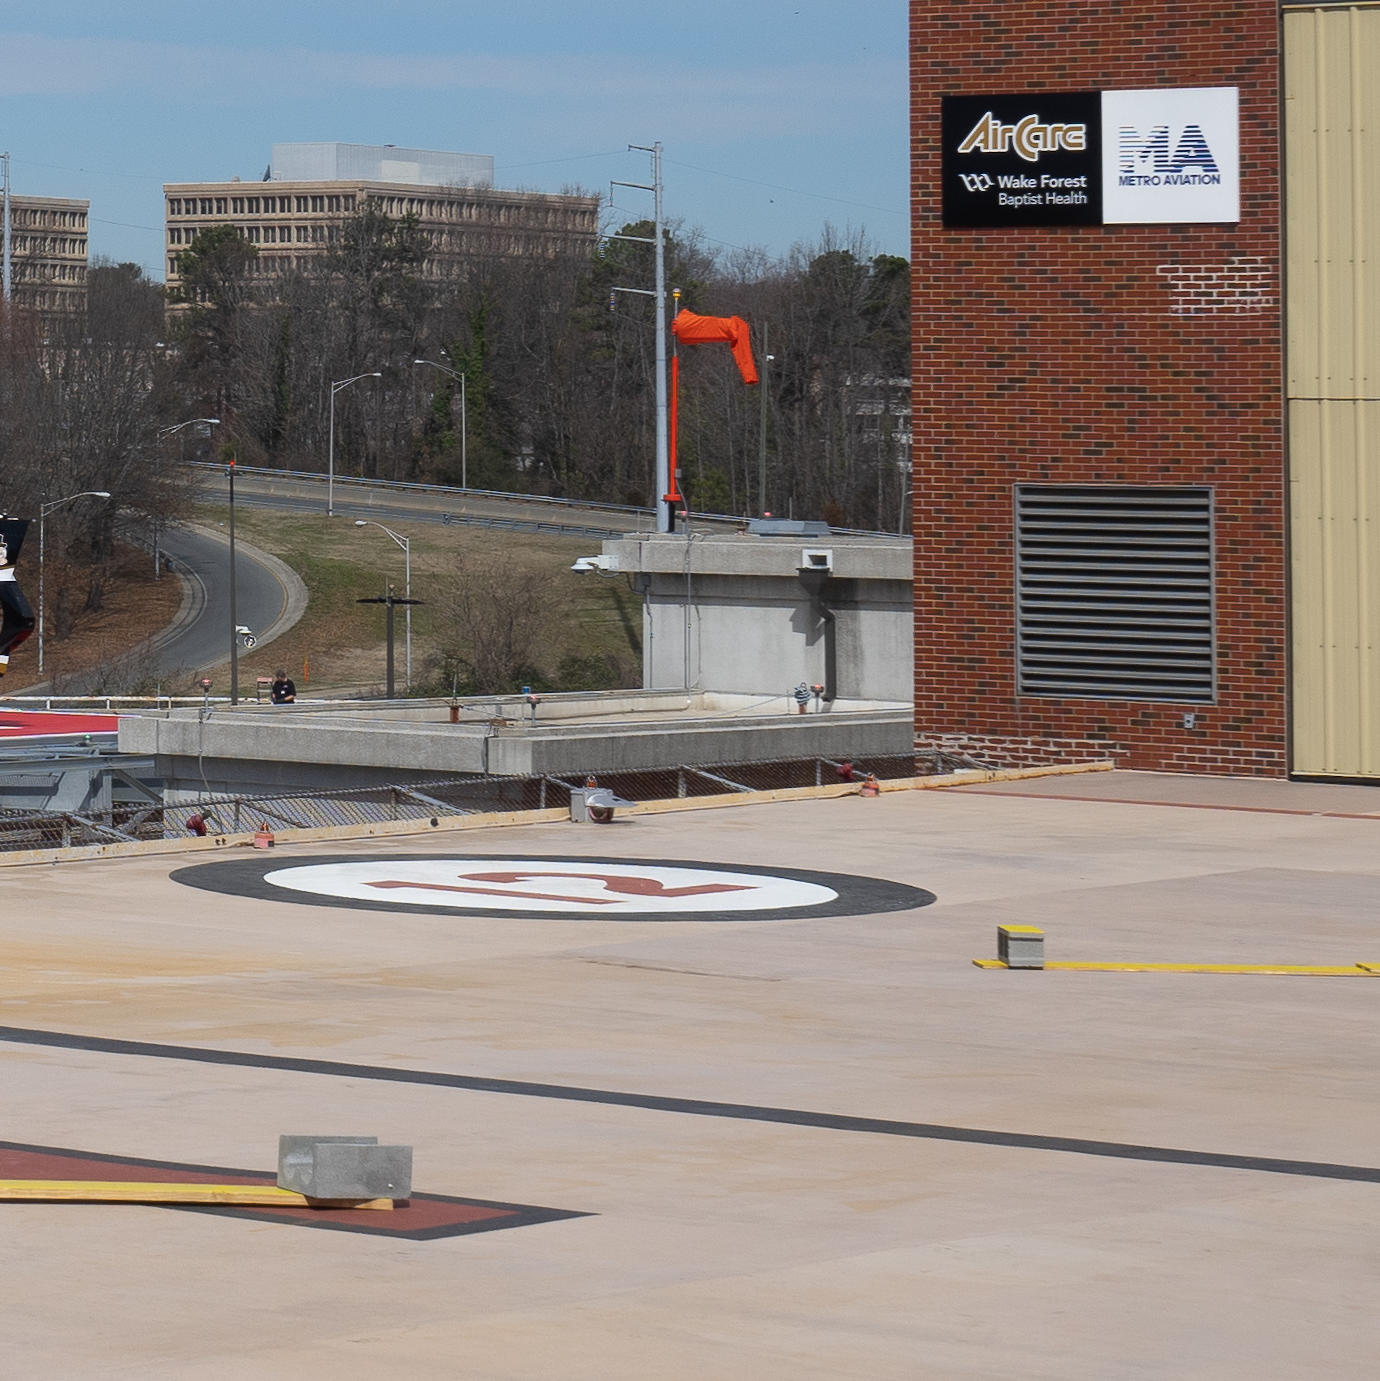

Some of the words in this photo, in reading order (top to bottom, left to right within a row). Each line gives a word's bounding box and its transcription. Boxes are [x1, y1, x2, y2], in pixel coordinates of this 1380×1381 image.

[957, 111, 1087, 161] AirCare
[1119, 125, 1219, 173] MA
[997, 175, 1037, 189] Wake
[1040, 174, 1088, 189] Forest
[1119, 175, 1161, 186] METRO
[1163, 174, 1221, 186] AVIATION
[999, 192, 1043, 209] Baptist
[1045, 191, 1088, 205] Health
